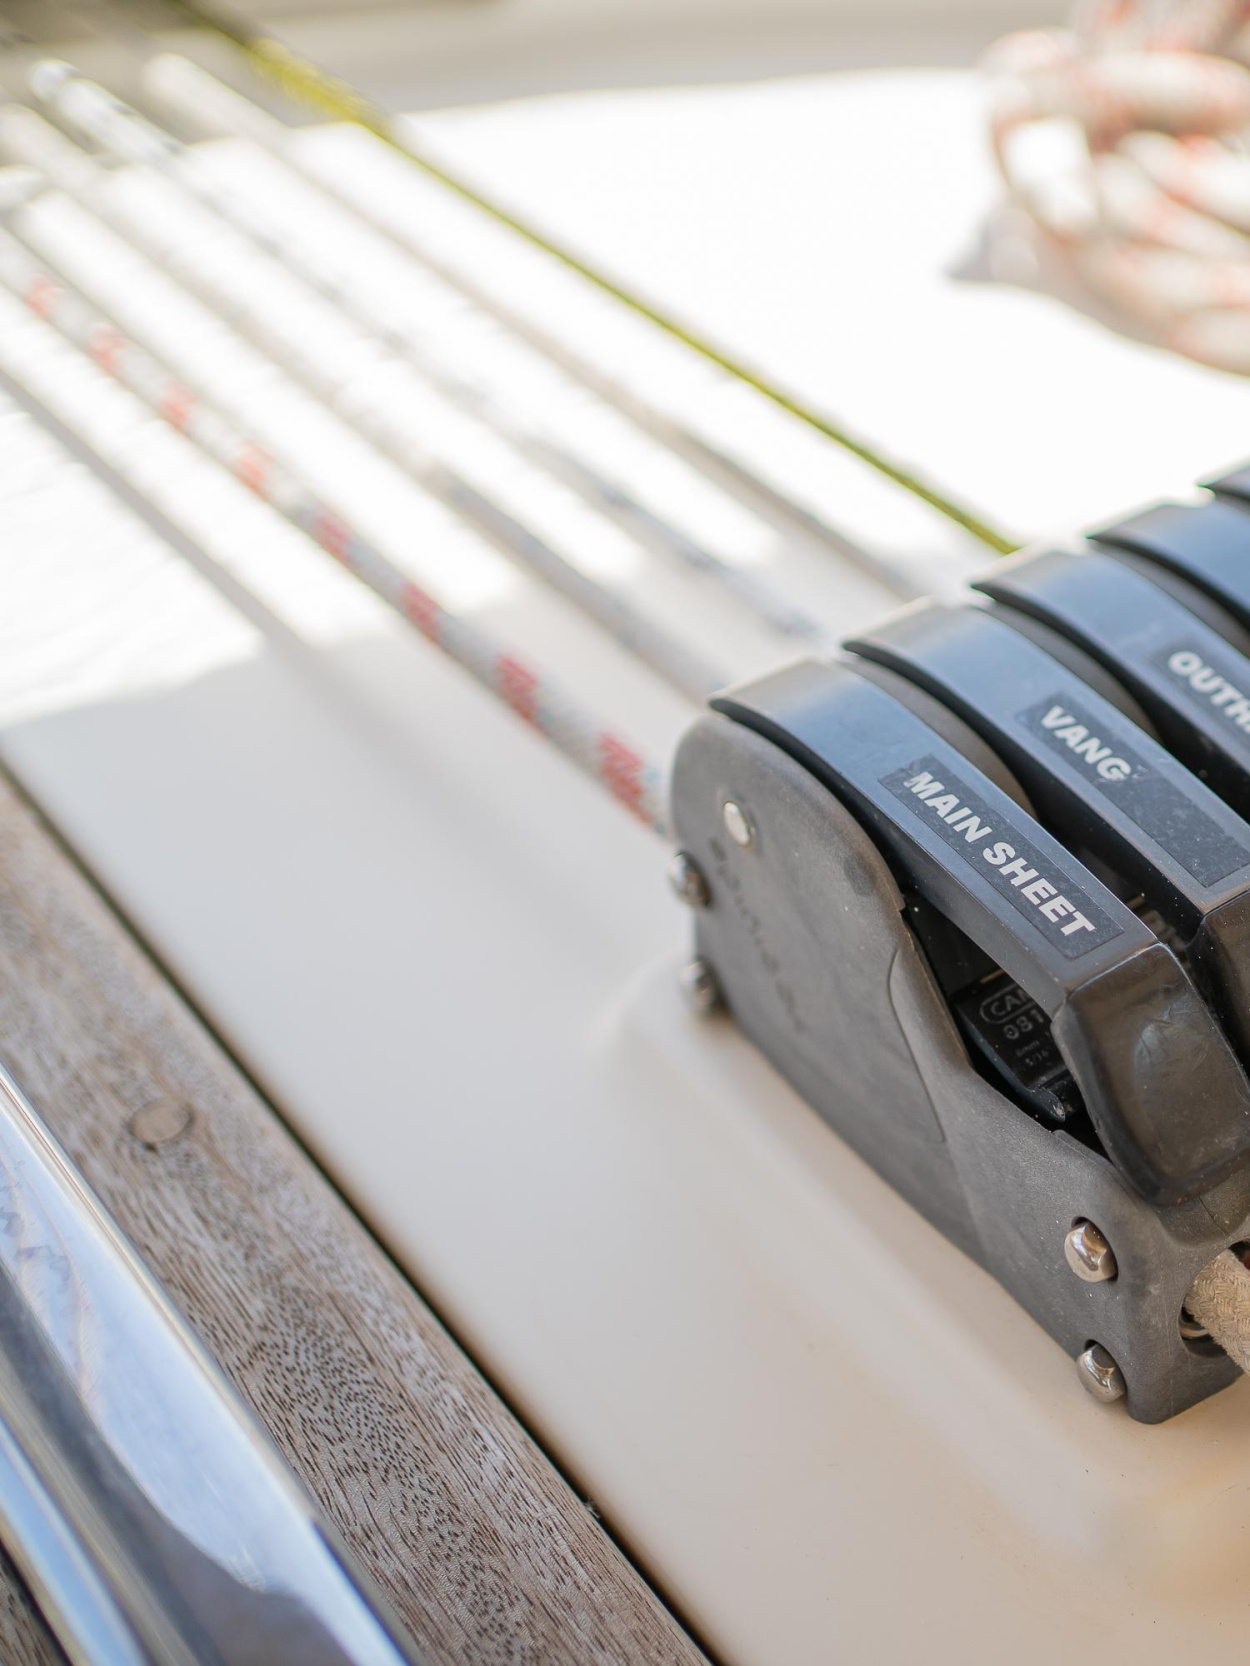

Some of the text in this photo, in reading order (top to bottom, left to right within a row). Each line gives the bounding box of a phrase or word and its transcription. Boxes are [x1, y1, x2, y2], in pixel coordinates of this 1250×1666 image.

[1040, 705, 1131, 780] VANG
[903, 771, 992, 843] MAIN
[982, 841, 1096, 936] SHEET
